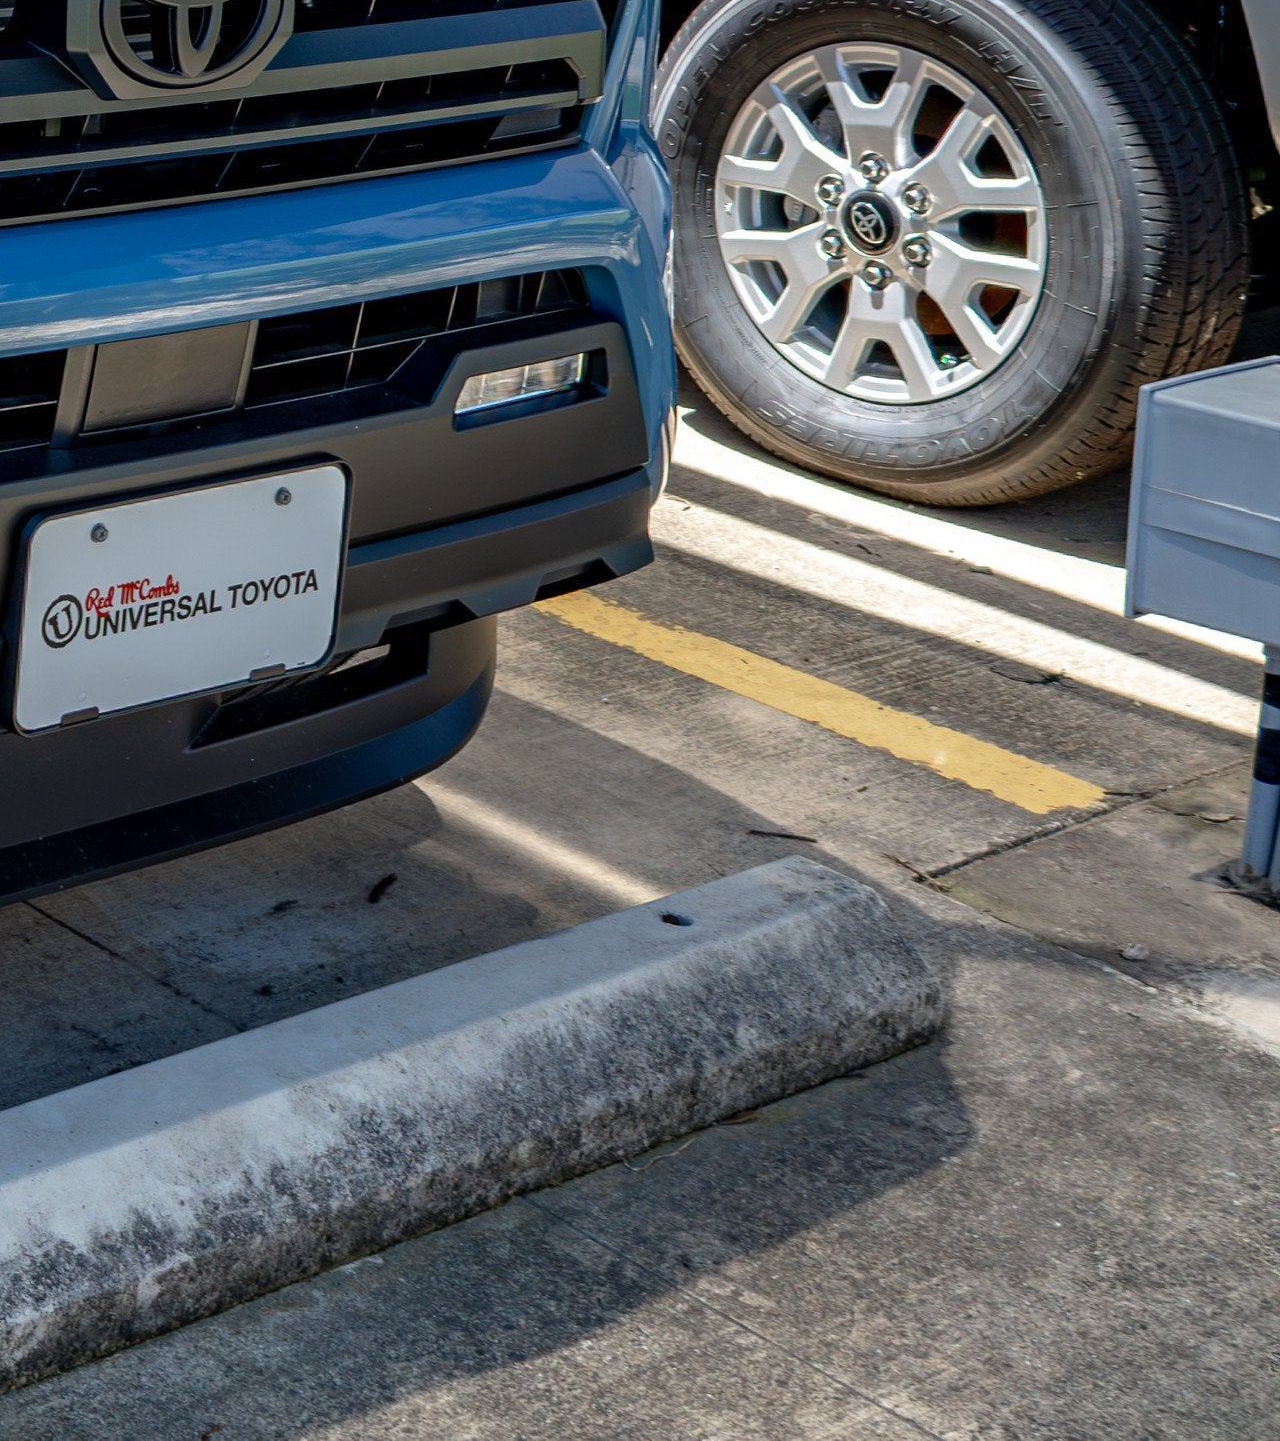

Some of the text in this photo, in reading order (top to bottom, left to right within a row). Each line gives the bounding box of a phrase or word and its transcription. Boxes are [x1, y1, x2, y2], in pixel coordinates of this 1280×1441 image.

[660, 32, 736, 159] OPEN
[753, 400, 1029, 466] TOYO TIRES
[83, 569, 320, 640] UNIVERSAL TOYOTA
[85, 574, 180, 618] Red McCombs
